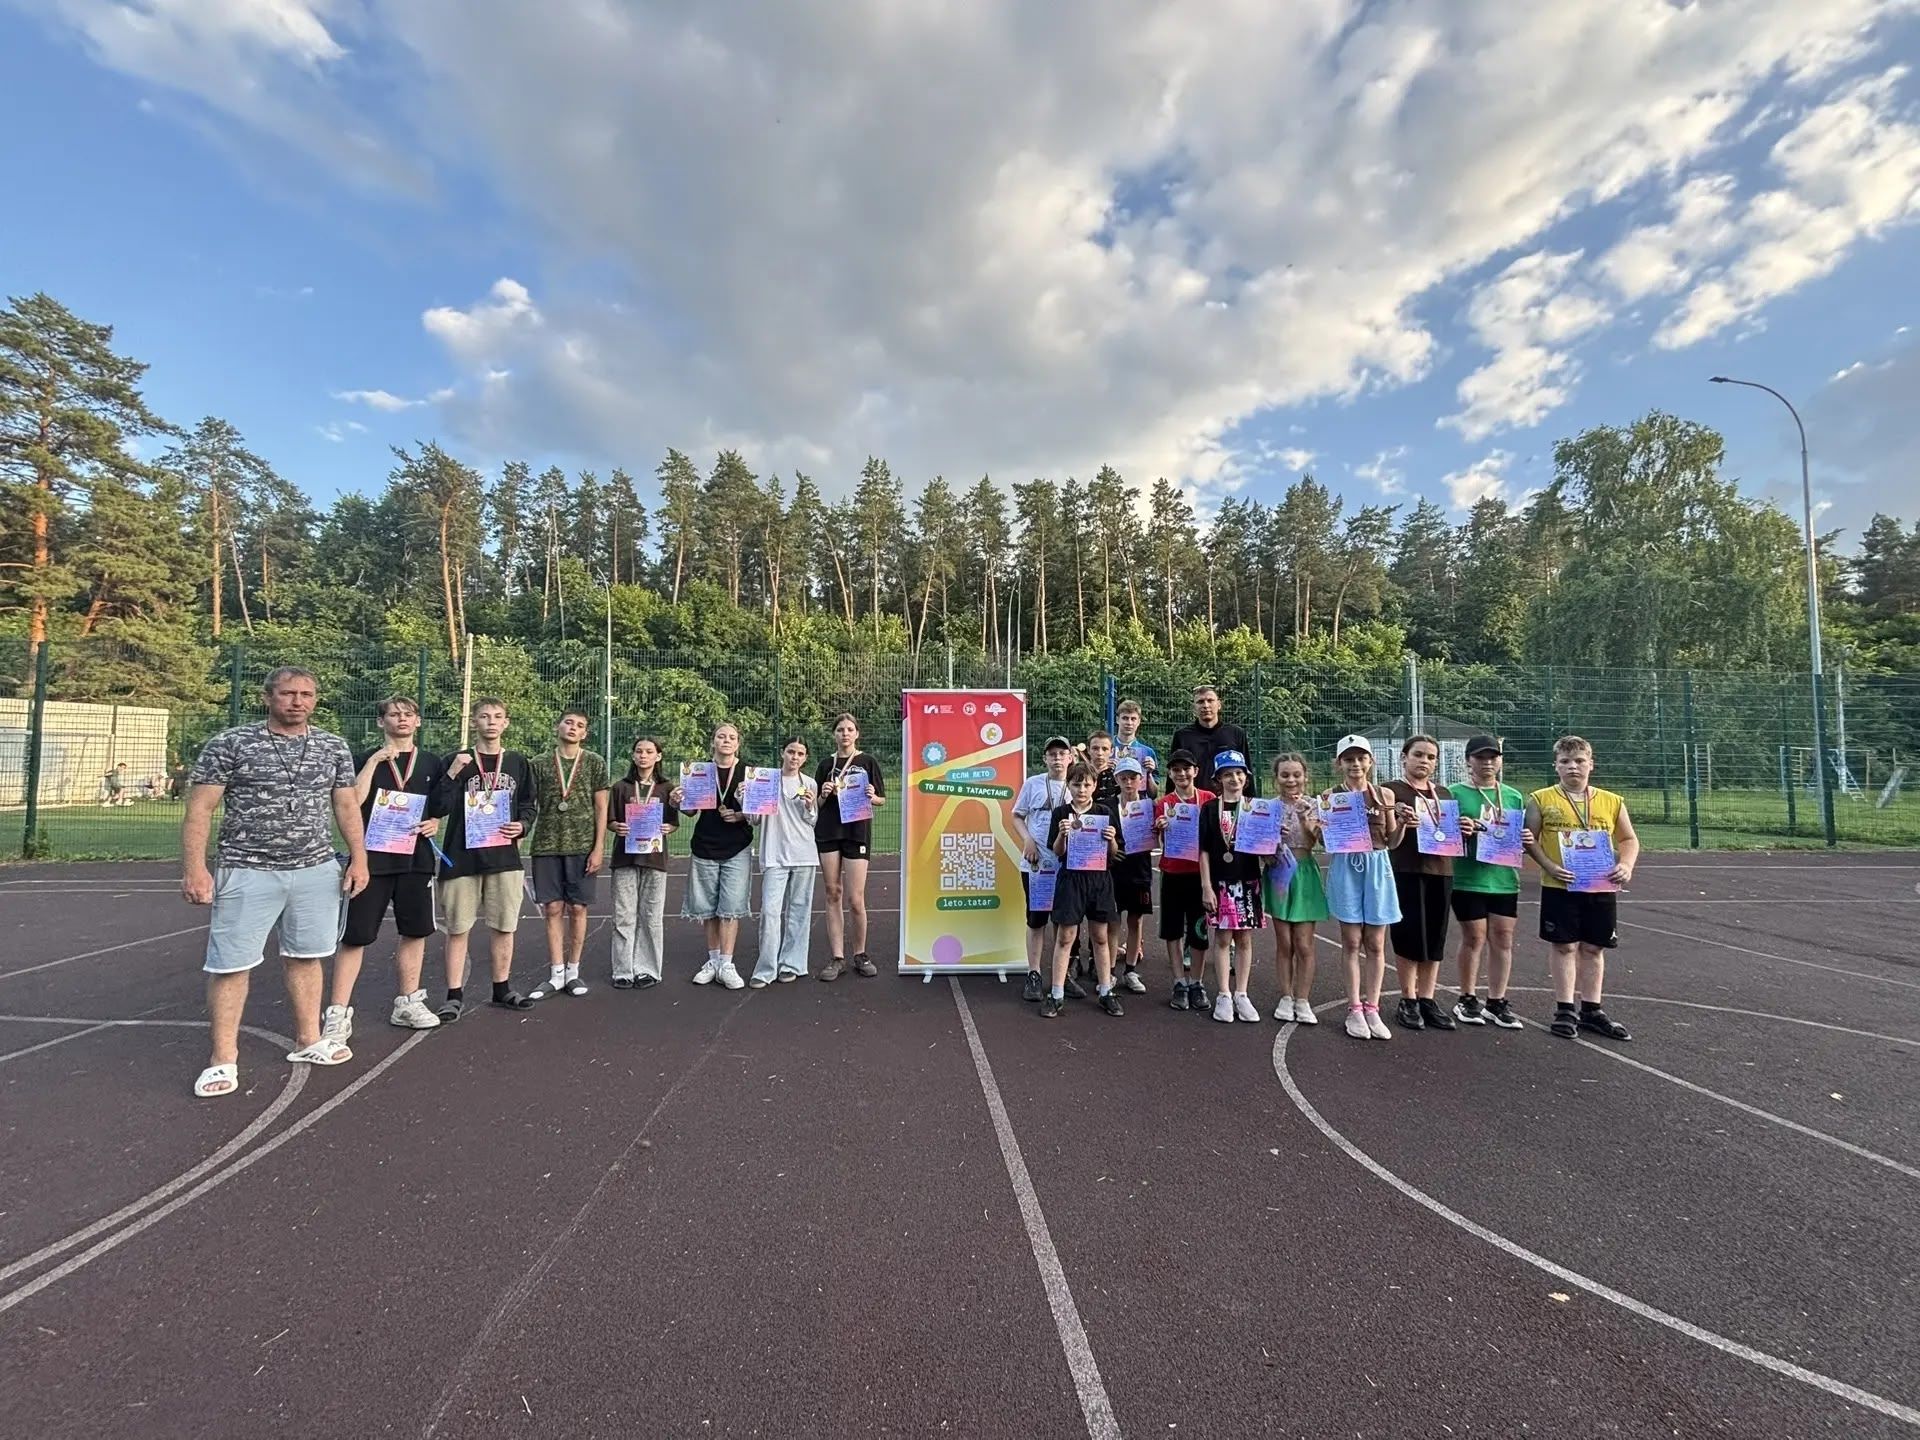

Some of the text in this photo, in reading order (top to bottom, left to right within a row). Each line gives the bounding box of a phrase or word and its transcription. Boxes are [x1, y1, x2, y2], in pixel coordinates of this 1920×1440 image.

[952, 772, 969, 780] ЕСЛИ
[924, 783, 935, 791] ТО
[966, 787, 1009, 797] ТАТАРСТАНЕ
[943, 898, 992, 907] leto.tatar
